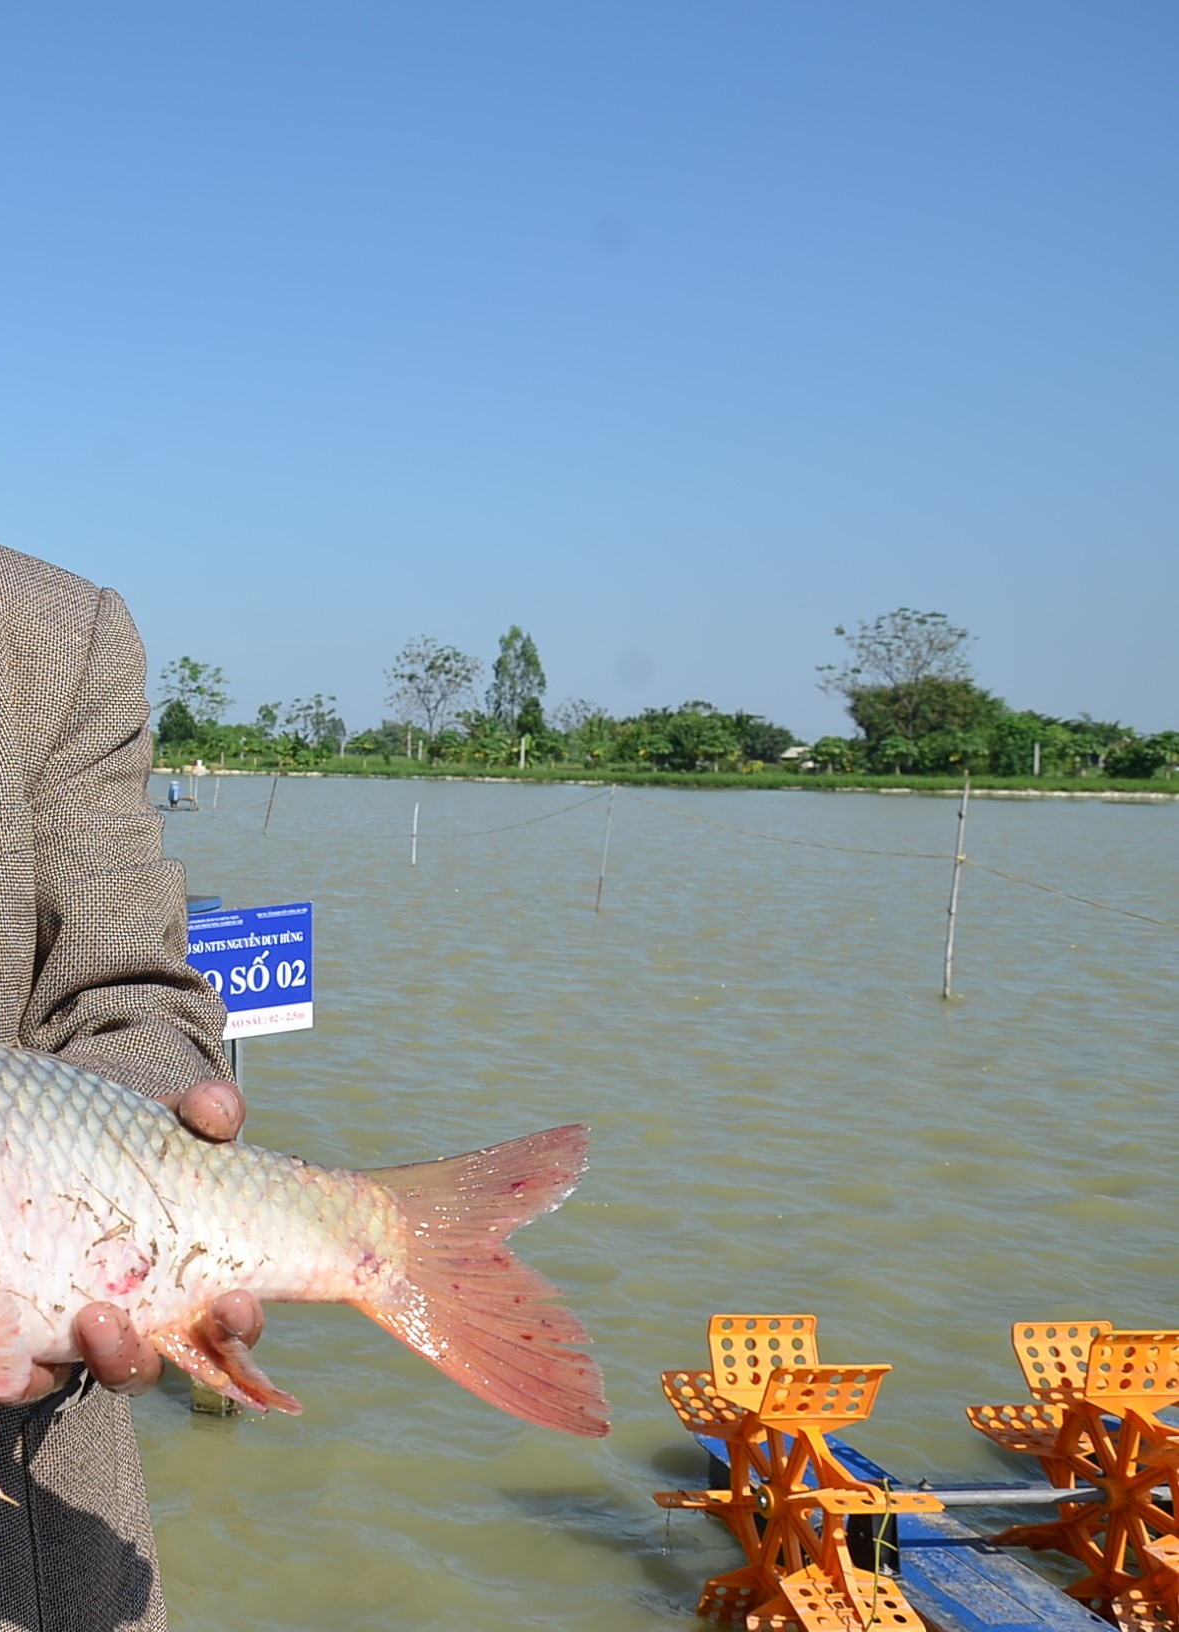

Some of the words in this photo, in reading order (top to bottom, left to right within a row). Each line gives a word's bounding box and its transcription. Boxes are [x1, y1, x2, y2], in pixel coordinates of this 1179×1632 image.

[204, 939, 226, 954] NTTS
[227, 932, 260, 950] NGUYỄN
[262, 934, 279, 946] DUY
[230, 950, 270, 995] SỐ
[276, 959, 307, 988] 02
